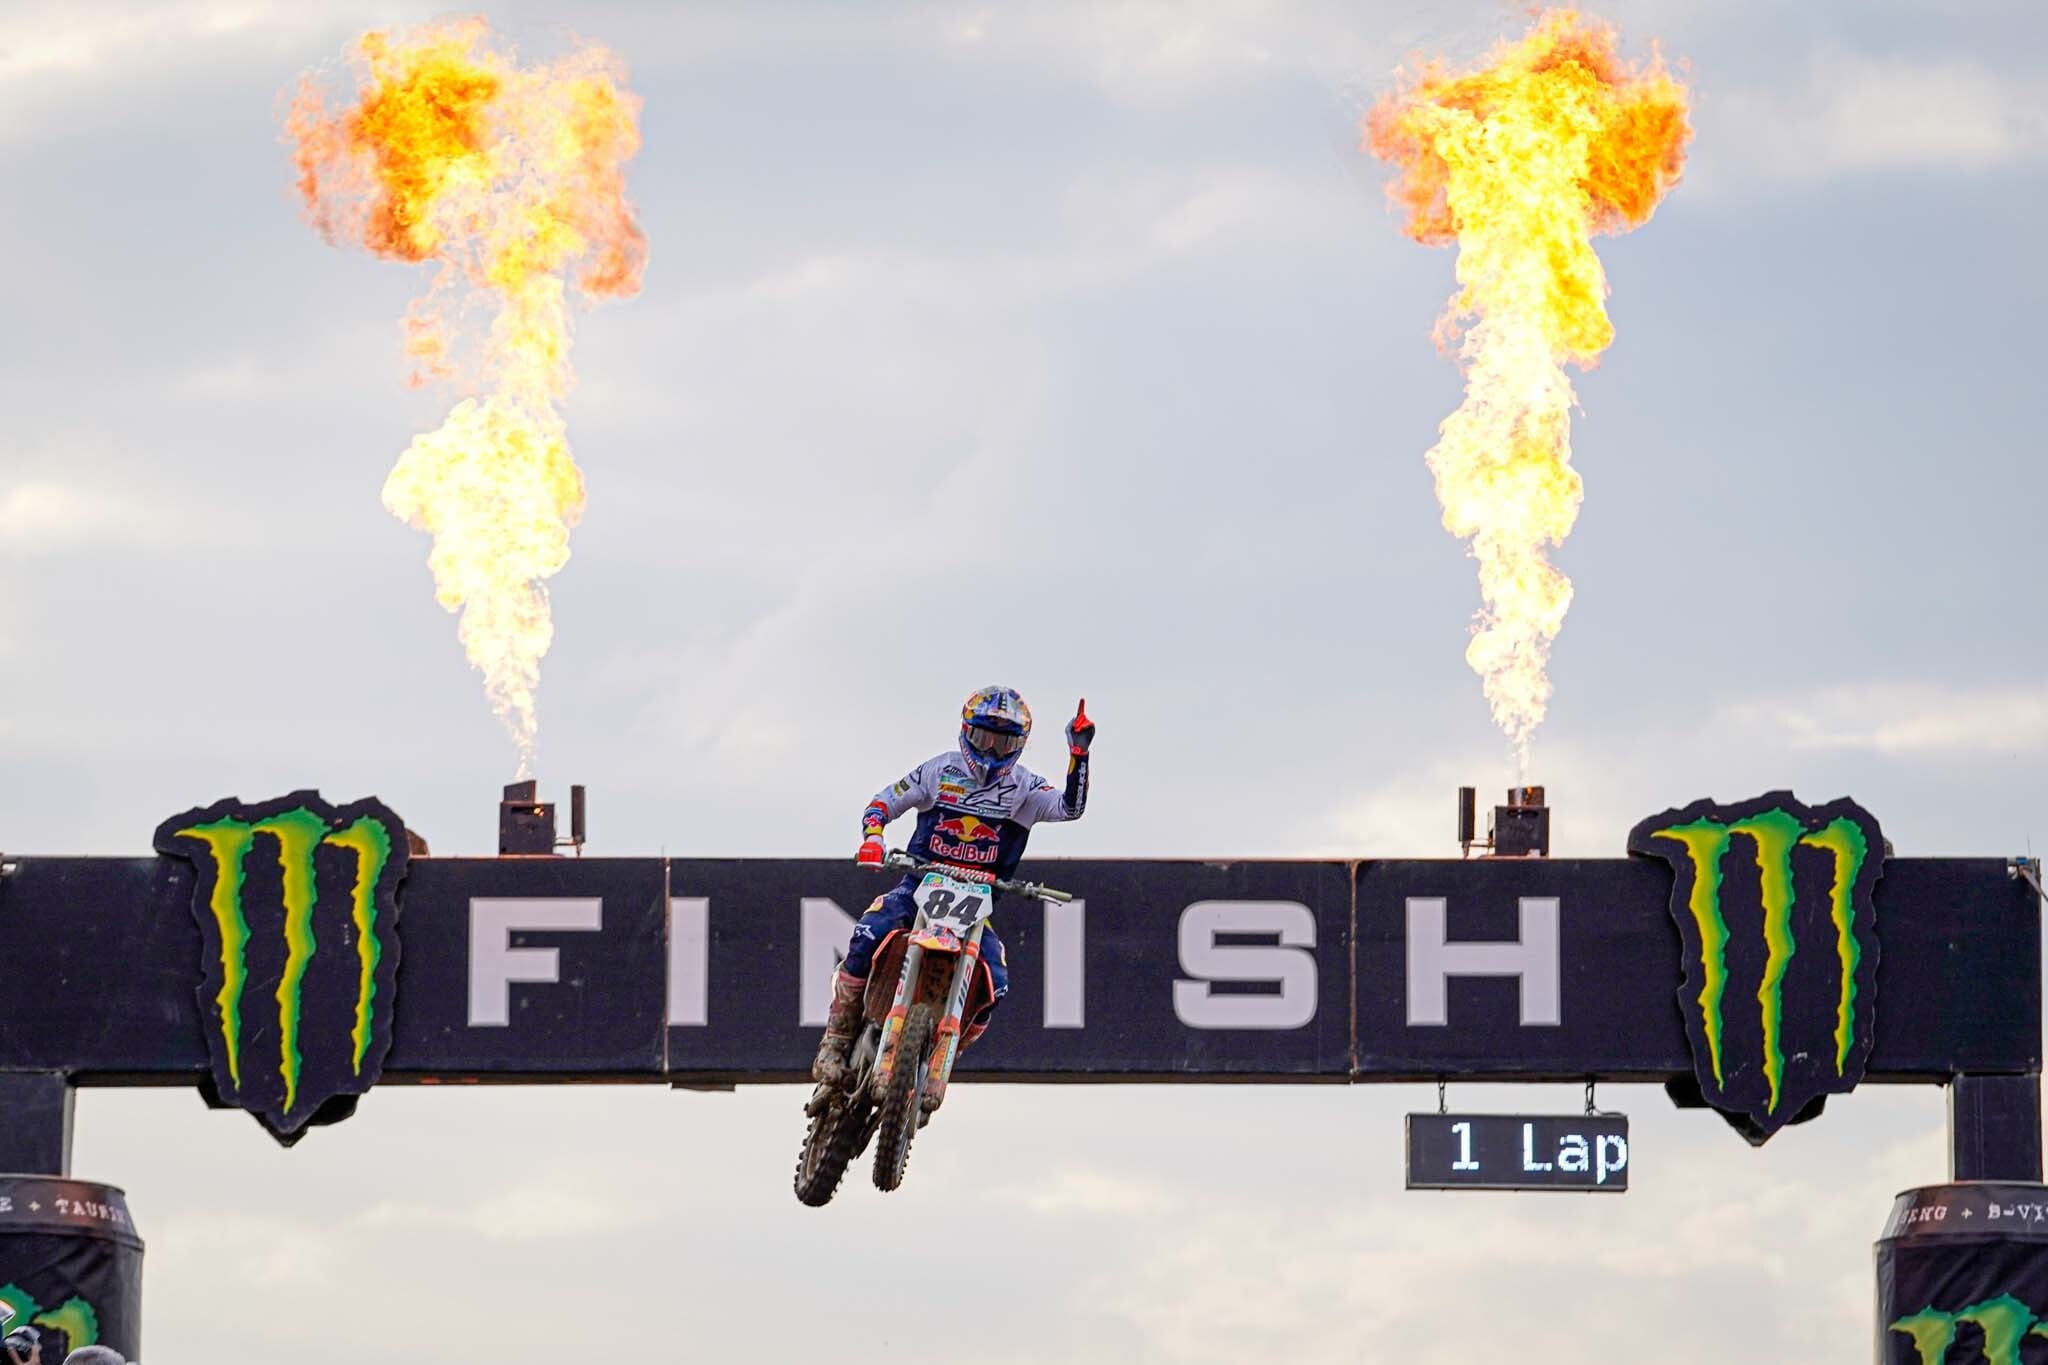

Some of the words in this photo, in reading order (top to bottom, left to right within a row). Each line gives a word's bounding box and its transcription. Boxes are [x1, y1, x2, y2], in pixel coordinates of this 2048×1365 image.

[929, 833, 964, 860] Red
[963, 844, 998, 863] Bull
[923, 889, 983, 926] 84
[1451, 1121, 1480, 1171] 1
[1522, 1122, 1628, 1184] Lap
[1987, 1202, 2048, 1222] B-VI
